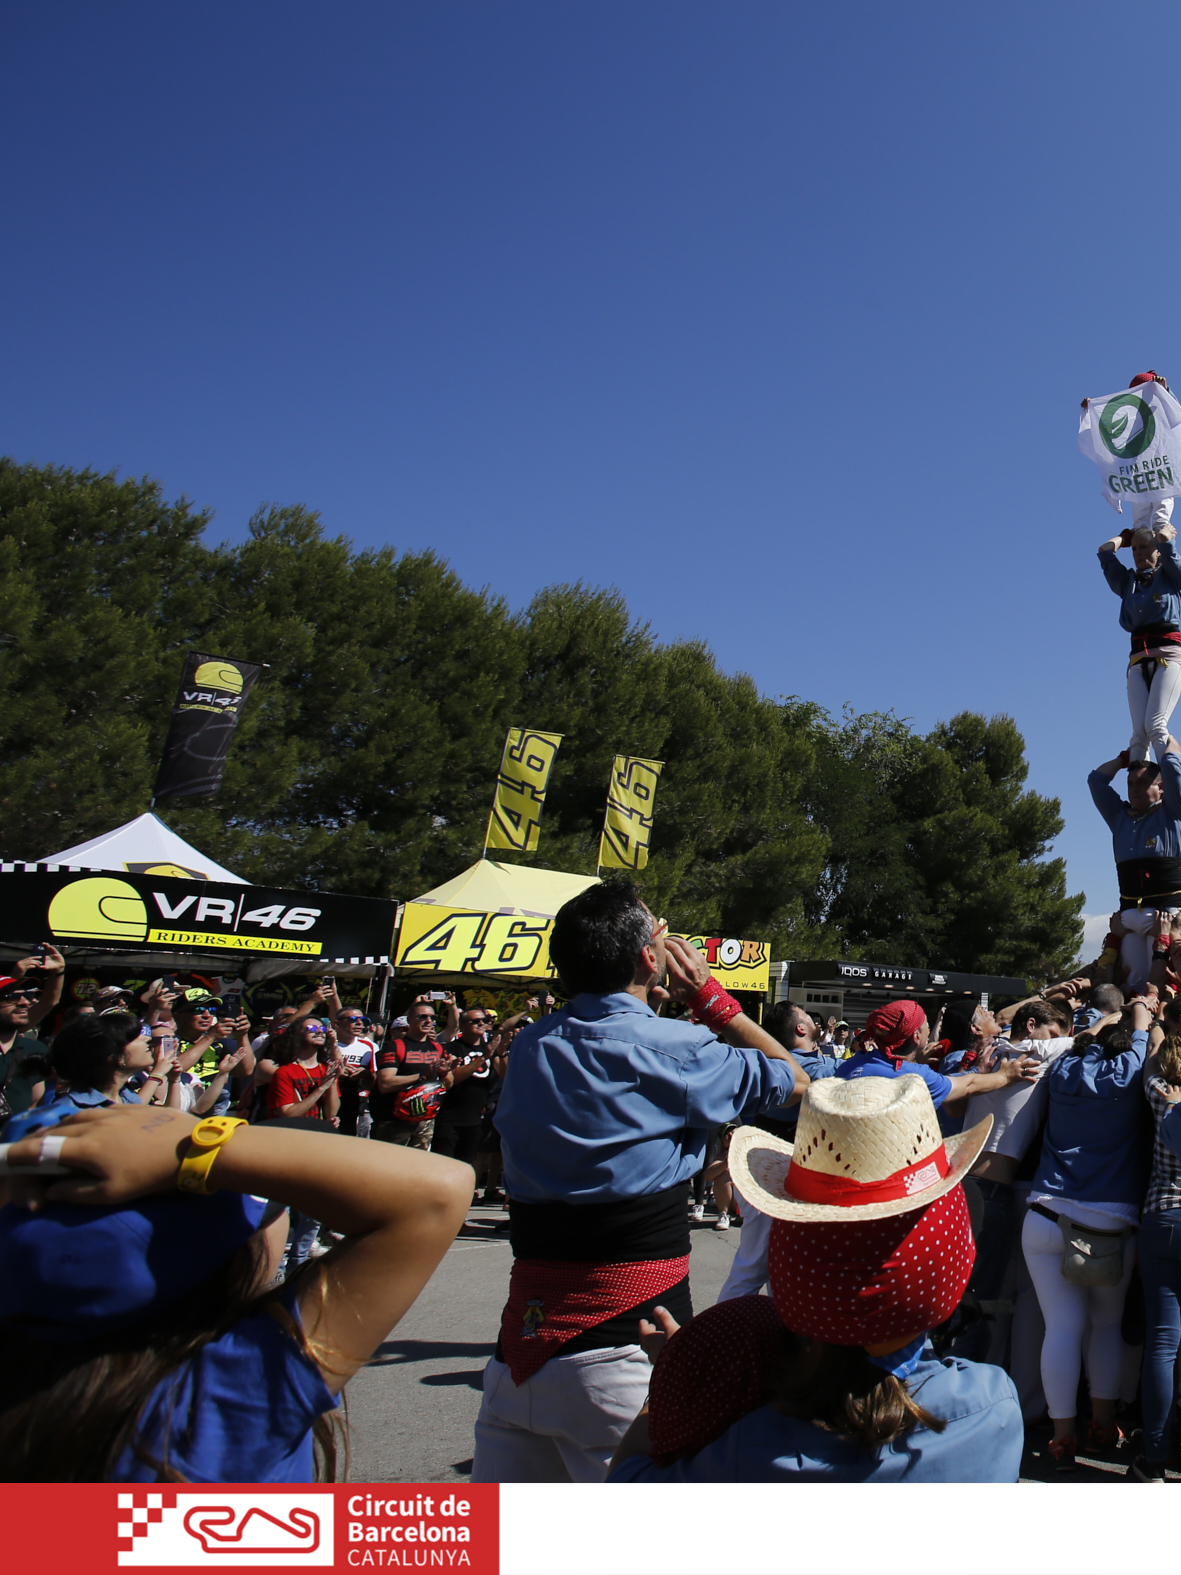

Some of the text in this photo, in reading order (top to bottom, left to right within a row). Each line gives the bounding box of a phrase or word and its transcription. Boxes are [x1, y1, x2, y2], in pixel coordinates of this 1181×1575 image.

[1119, 455, 1170, 476] FIM RIDE
[1108, 466, 1174, 493] GREEN
[493, 728, 559, 850] 46
[604, 756, 660, 869] 46
[156, 932, 317, 953] RIDERS ACADEMY
[402, 912, 549, 972] 46
[841, 966, 912, 980] IQOS GARAGE
